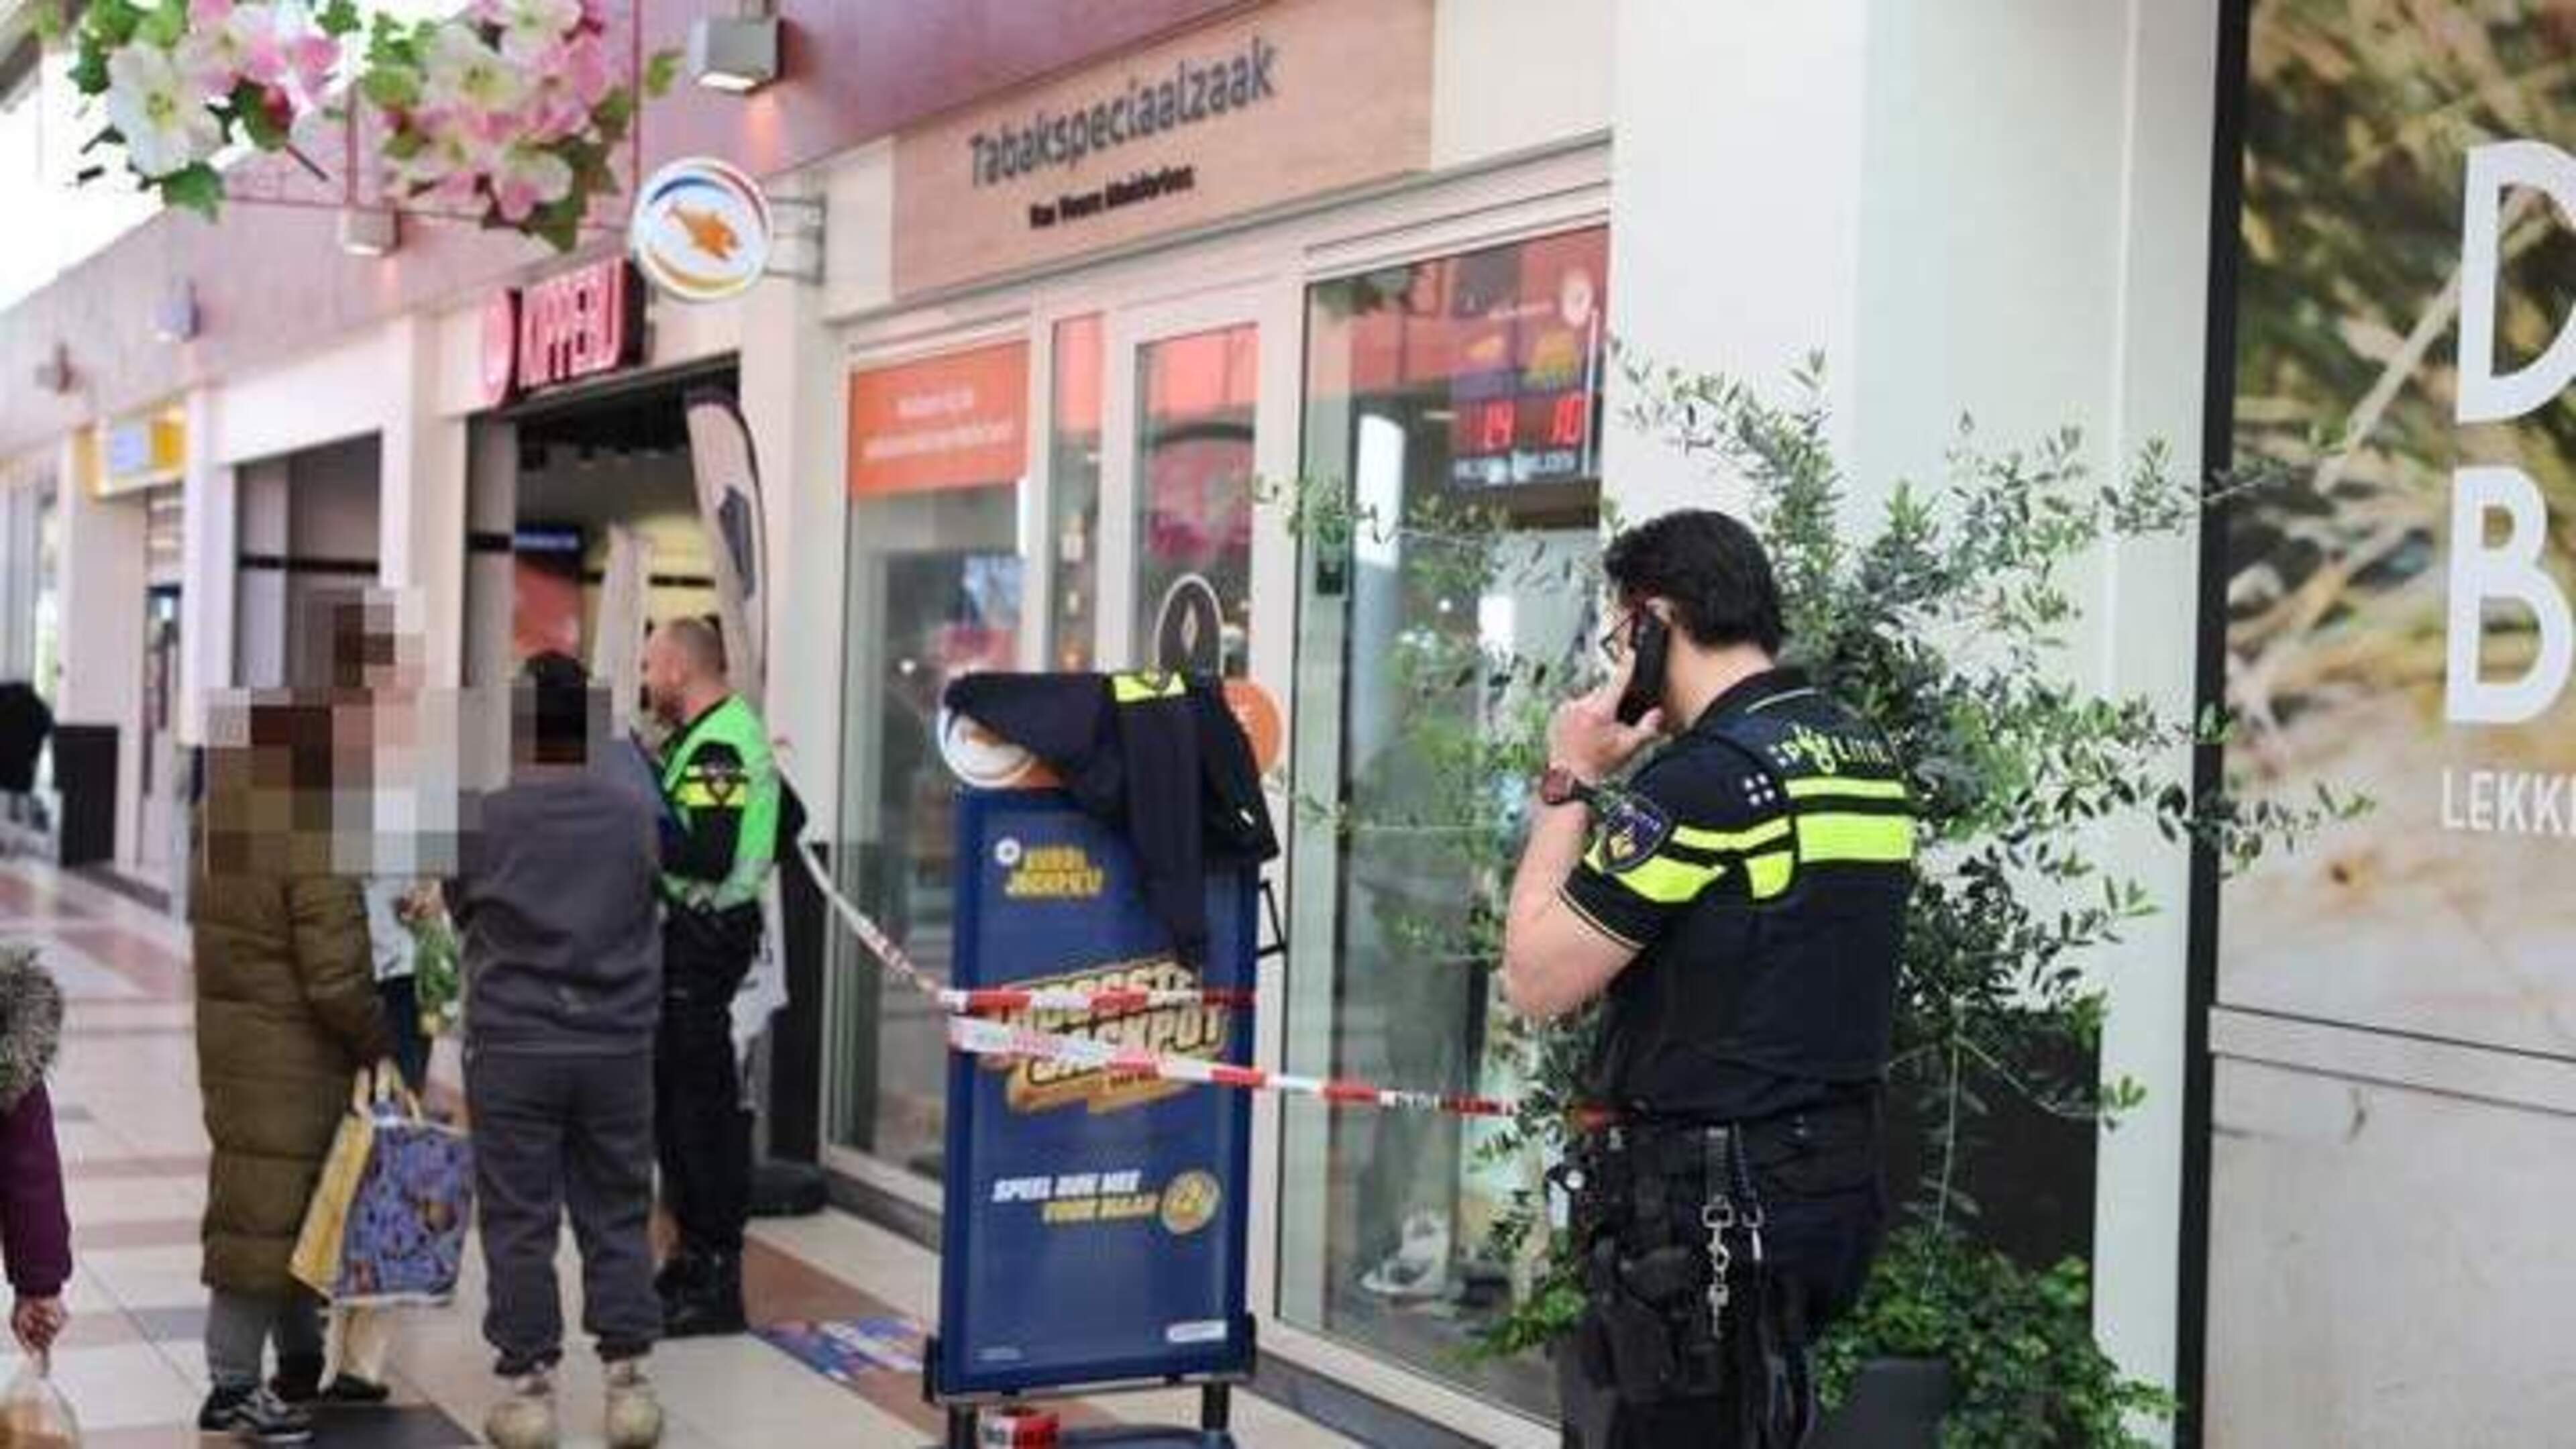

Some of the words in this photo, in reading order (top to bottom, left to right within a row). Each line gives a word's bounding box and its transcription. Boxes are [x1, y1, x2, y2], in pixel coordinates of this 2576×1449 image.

[969, 36, 1275, 186] Tabakspeciaalzaak
[2445, 466, 2574, 724] B
[2442, 769, 2576, 835] LEKK
